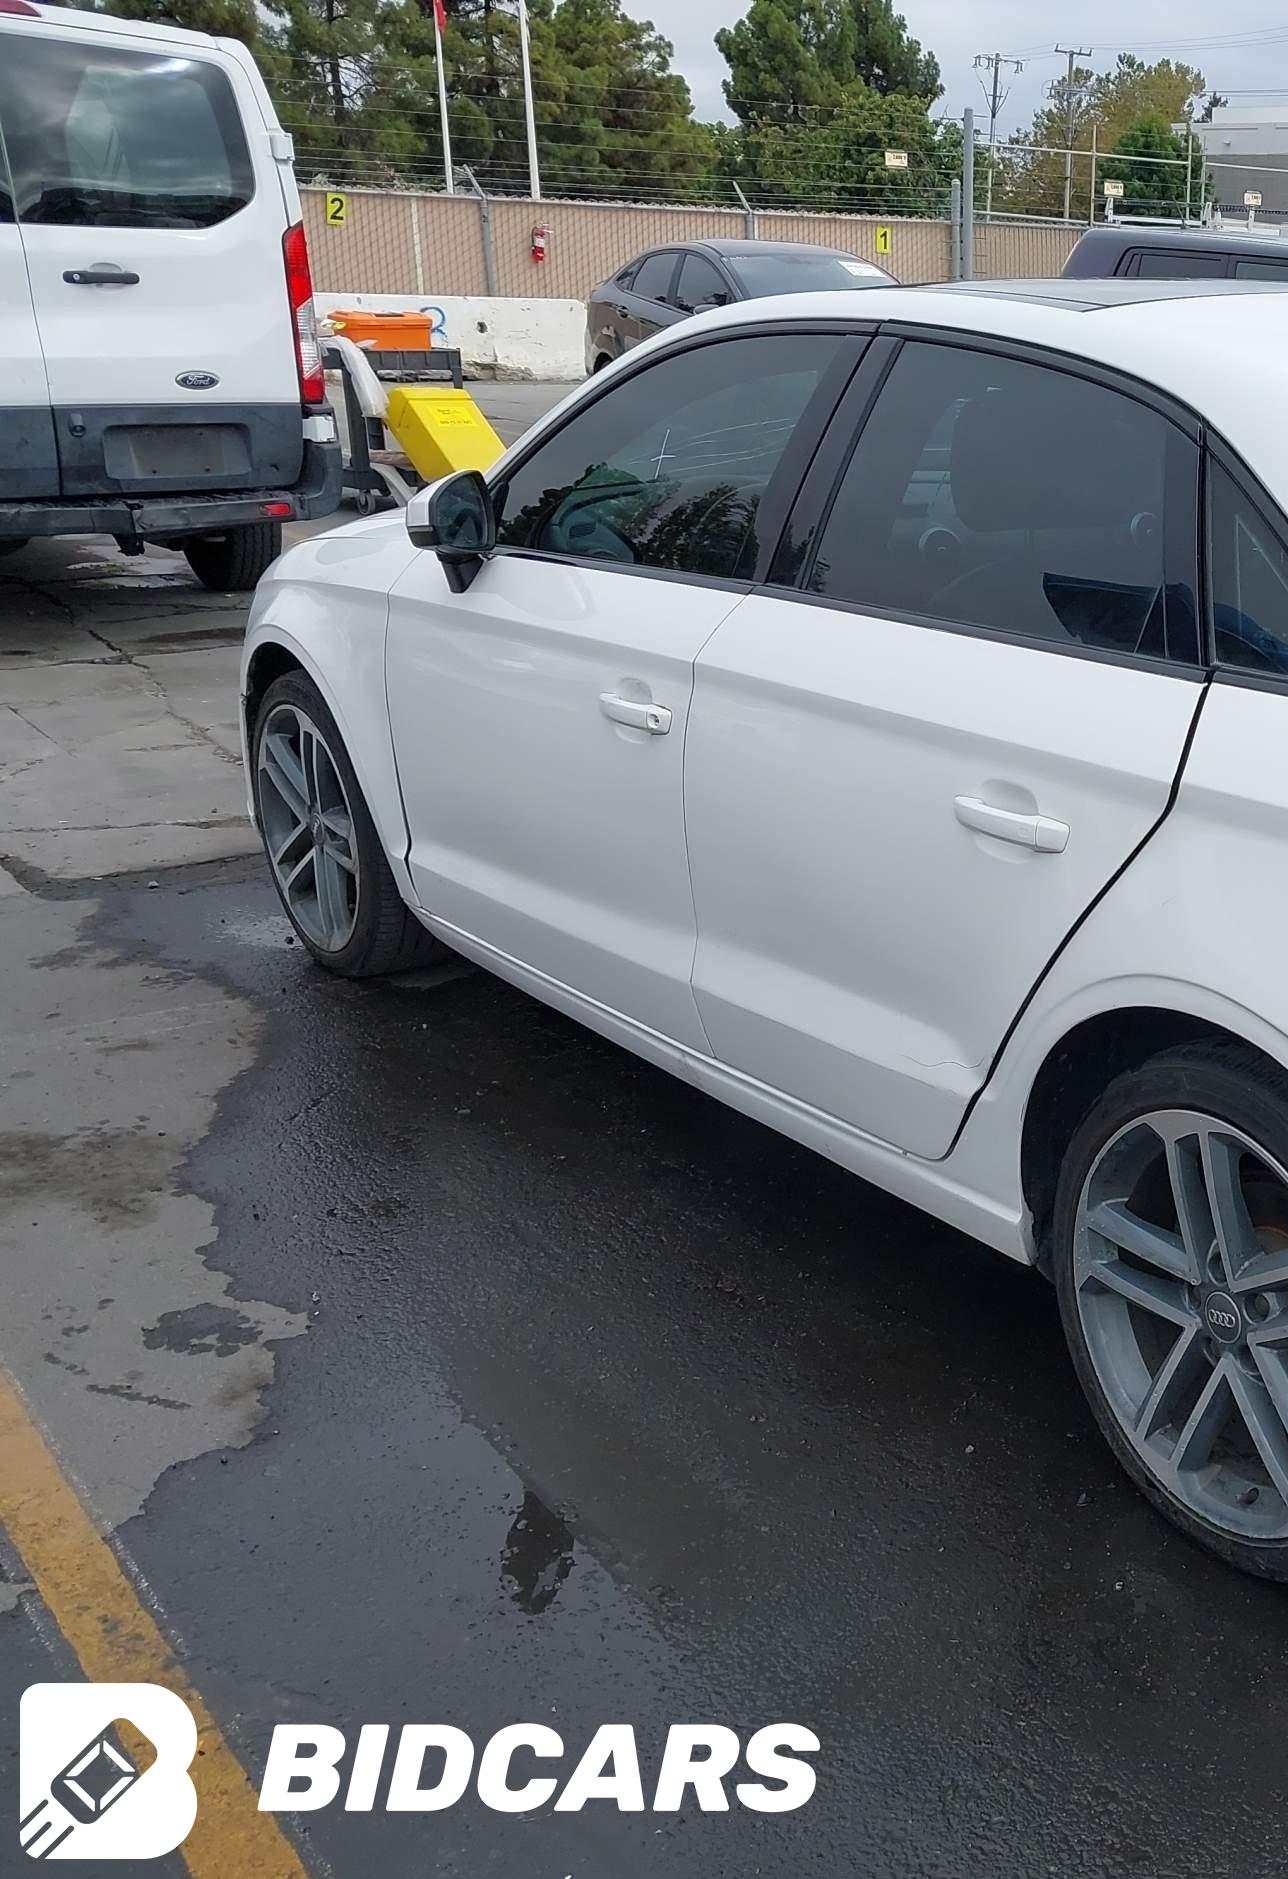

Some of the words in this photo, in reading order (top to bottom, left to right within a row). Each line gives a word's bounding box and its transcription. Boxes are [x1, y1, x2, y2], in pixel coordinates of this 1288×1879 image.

[330, 197, 344, 221] 2
[880, 230, 888, 250] 1
[186, 375, 211, 385] Ford
